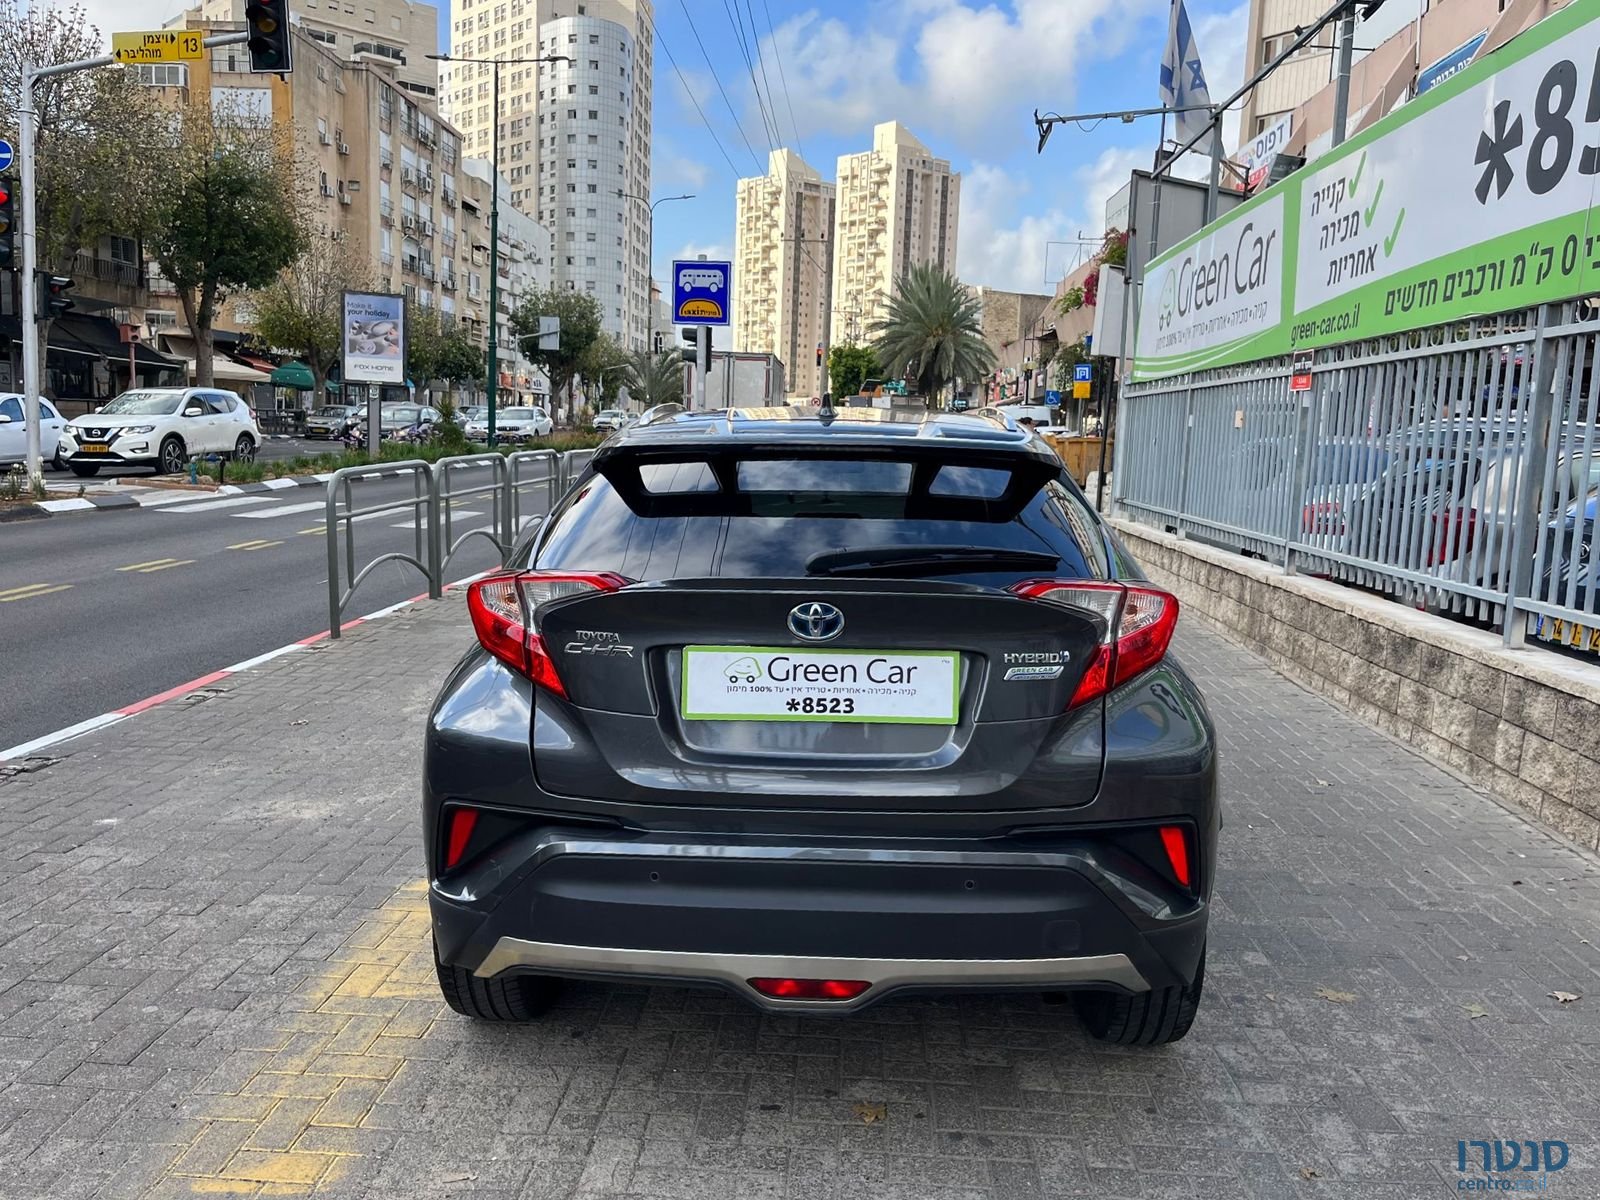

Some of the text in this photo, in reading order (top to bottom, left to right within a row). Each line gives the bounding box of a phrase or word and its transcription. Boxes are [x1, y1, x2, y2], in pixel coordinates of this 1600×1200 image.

[124, 46, 161, 58] מוהליבר
[143, 34, 168, 47] ויצמן
[183, 38, 198, 53] 13
[1256, 123, 1284, 159] דפוס
[1311, 177, 1346, 216] קנייה
[1320, 210, 1360, 250] מכירה
[1327, 243, 1378, 286] אחריות
[1561, 234, 1578, 276] 0
[1178, 222, 1276, 317] Green Car
[1442, 260, 1505, 303] ורכבים
[1384, 278, 1438, 316] חדשים
[364, 310, 390, 319] holiday
[1291, 303, 1361, 347] green-car.co.il
[564, 642, 634, 658] C-HR
[576, 630, 621, 643] TOYOTA
[767, 656, 918, 684] Green Car
[1004, 653, 1060, 663] HYBRID
[791, 686, 803, 694] אין
[899, 688, 917, 696] קניה
